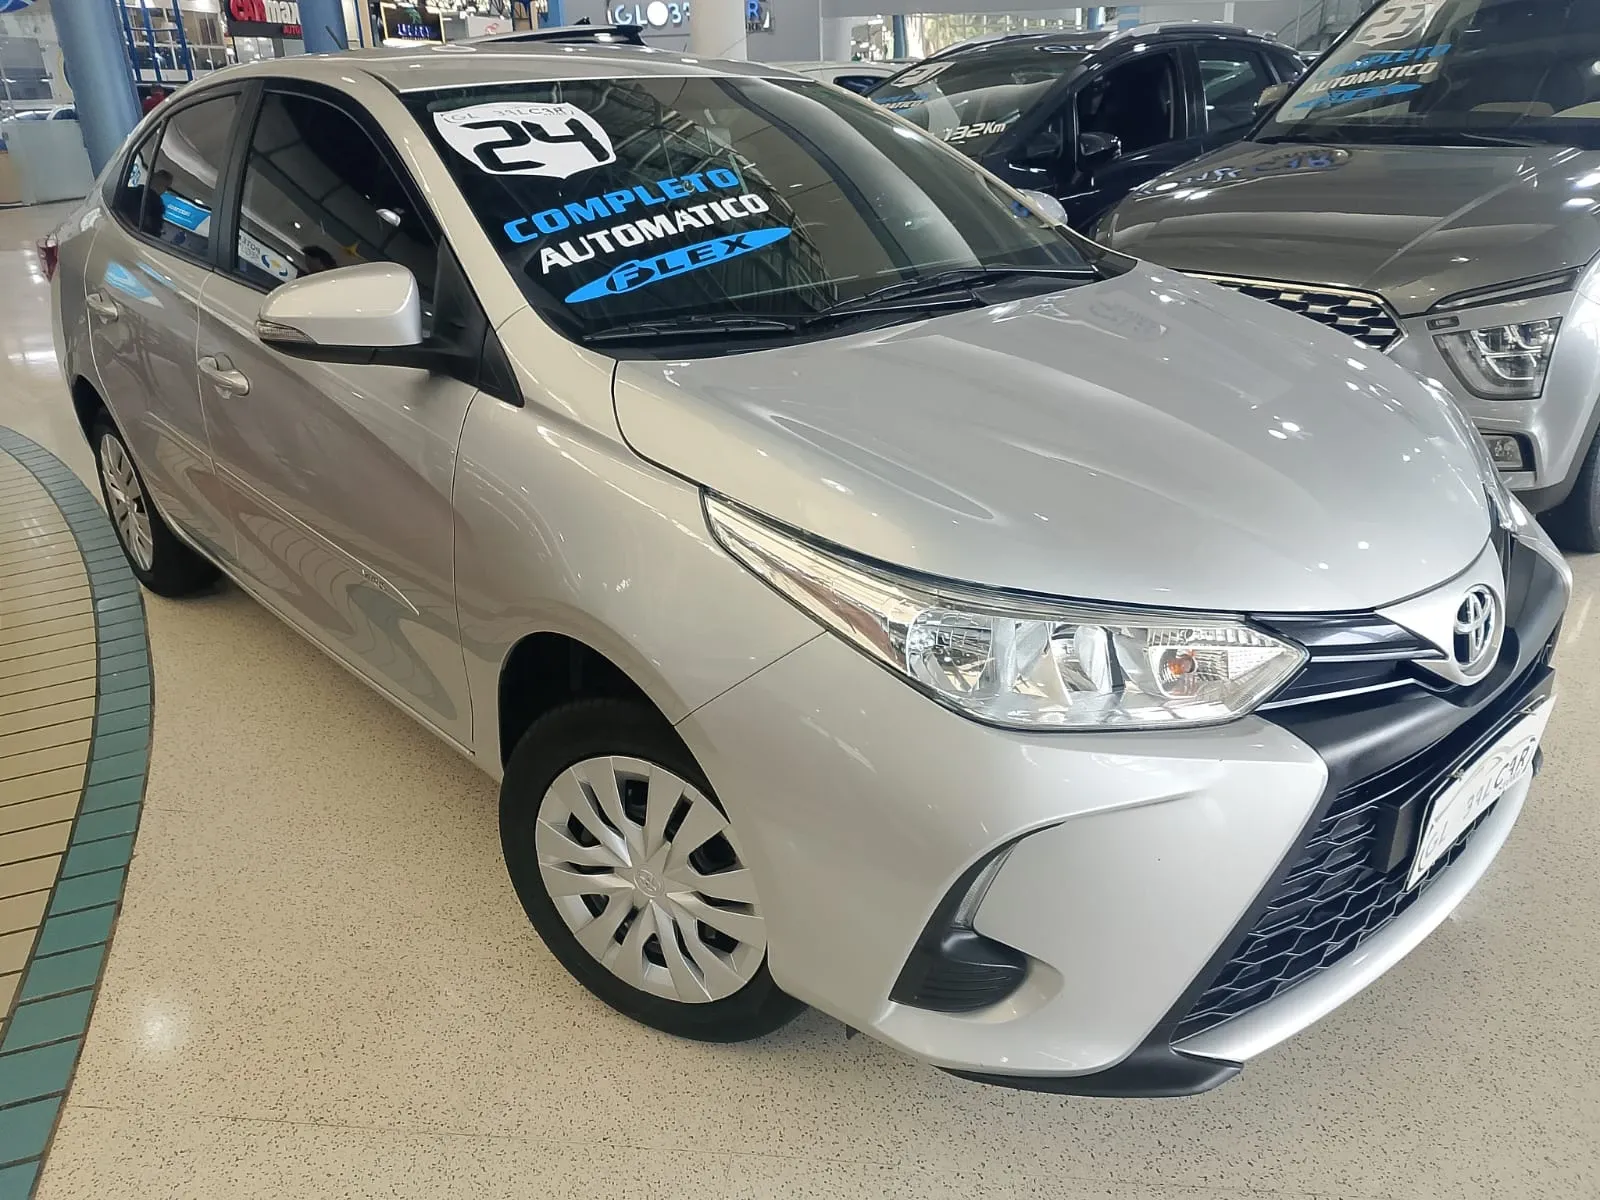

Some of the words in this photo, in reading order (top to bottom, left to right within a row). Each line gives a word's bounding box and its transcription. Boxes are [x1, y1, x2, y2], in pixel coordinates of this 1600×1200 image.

[458, 118, 611, 173] 24
[503, 167, 739, 244] COMPLETO
[609, 234, 754, 292] FLEX
